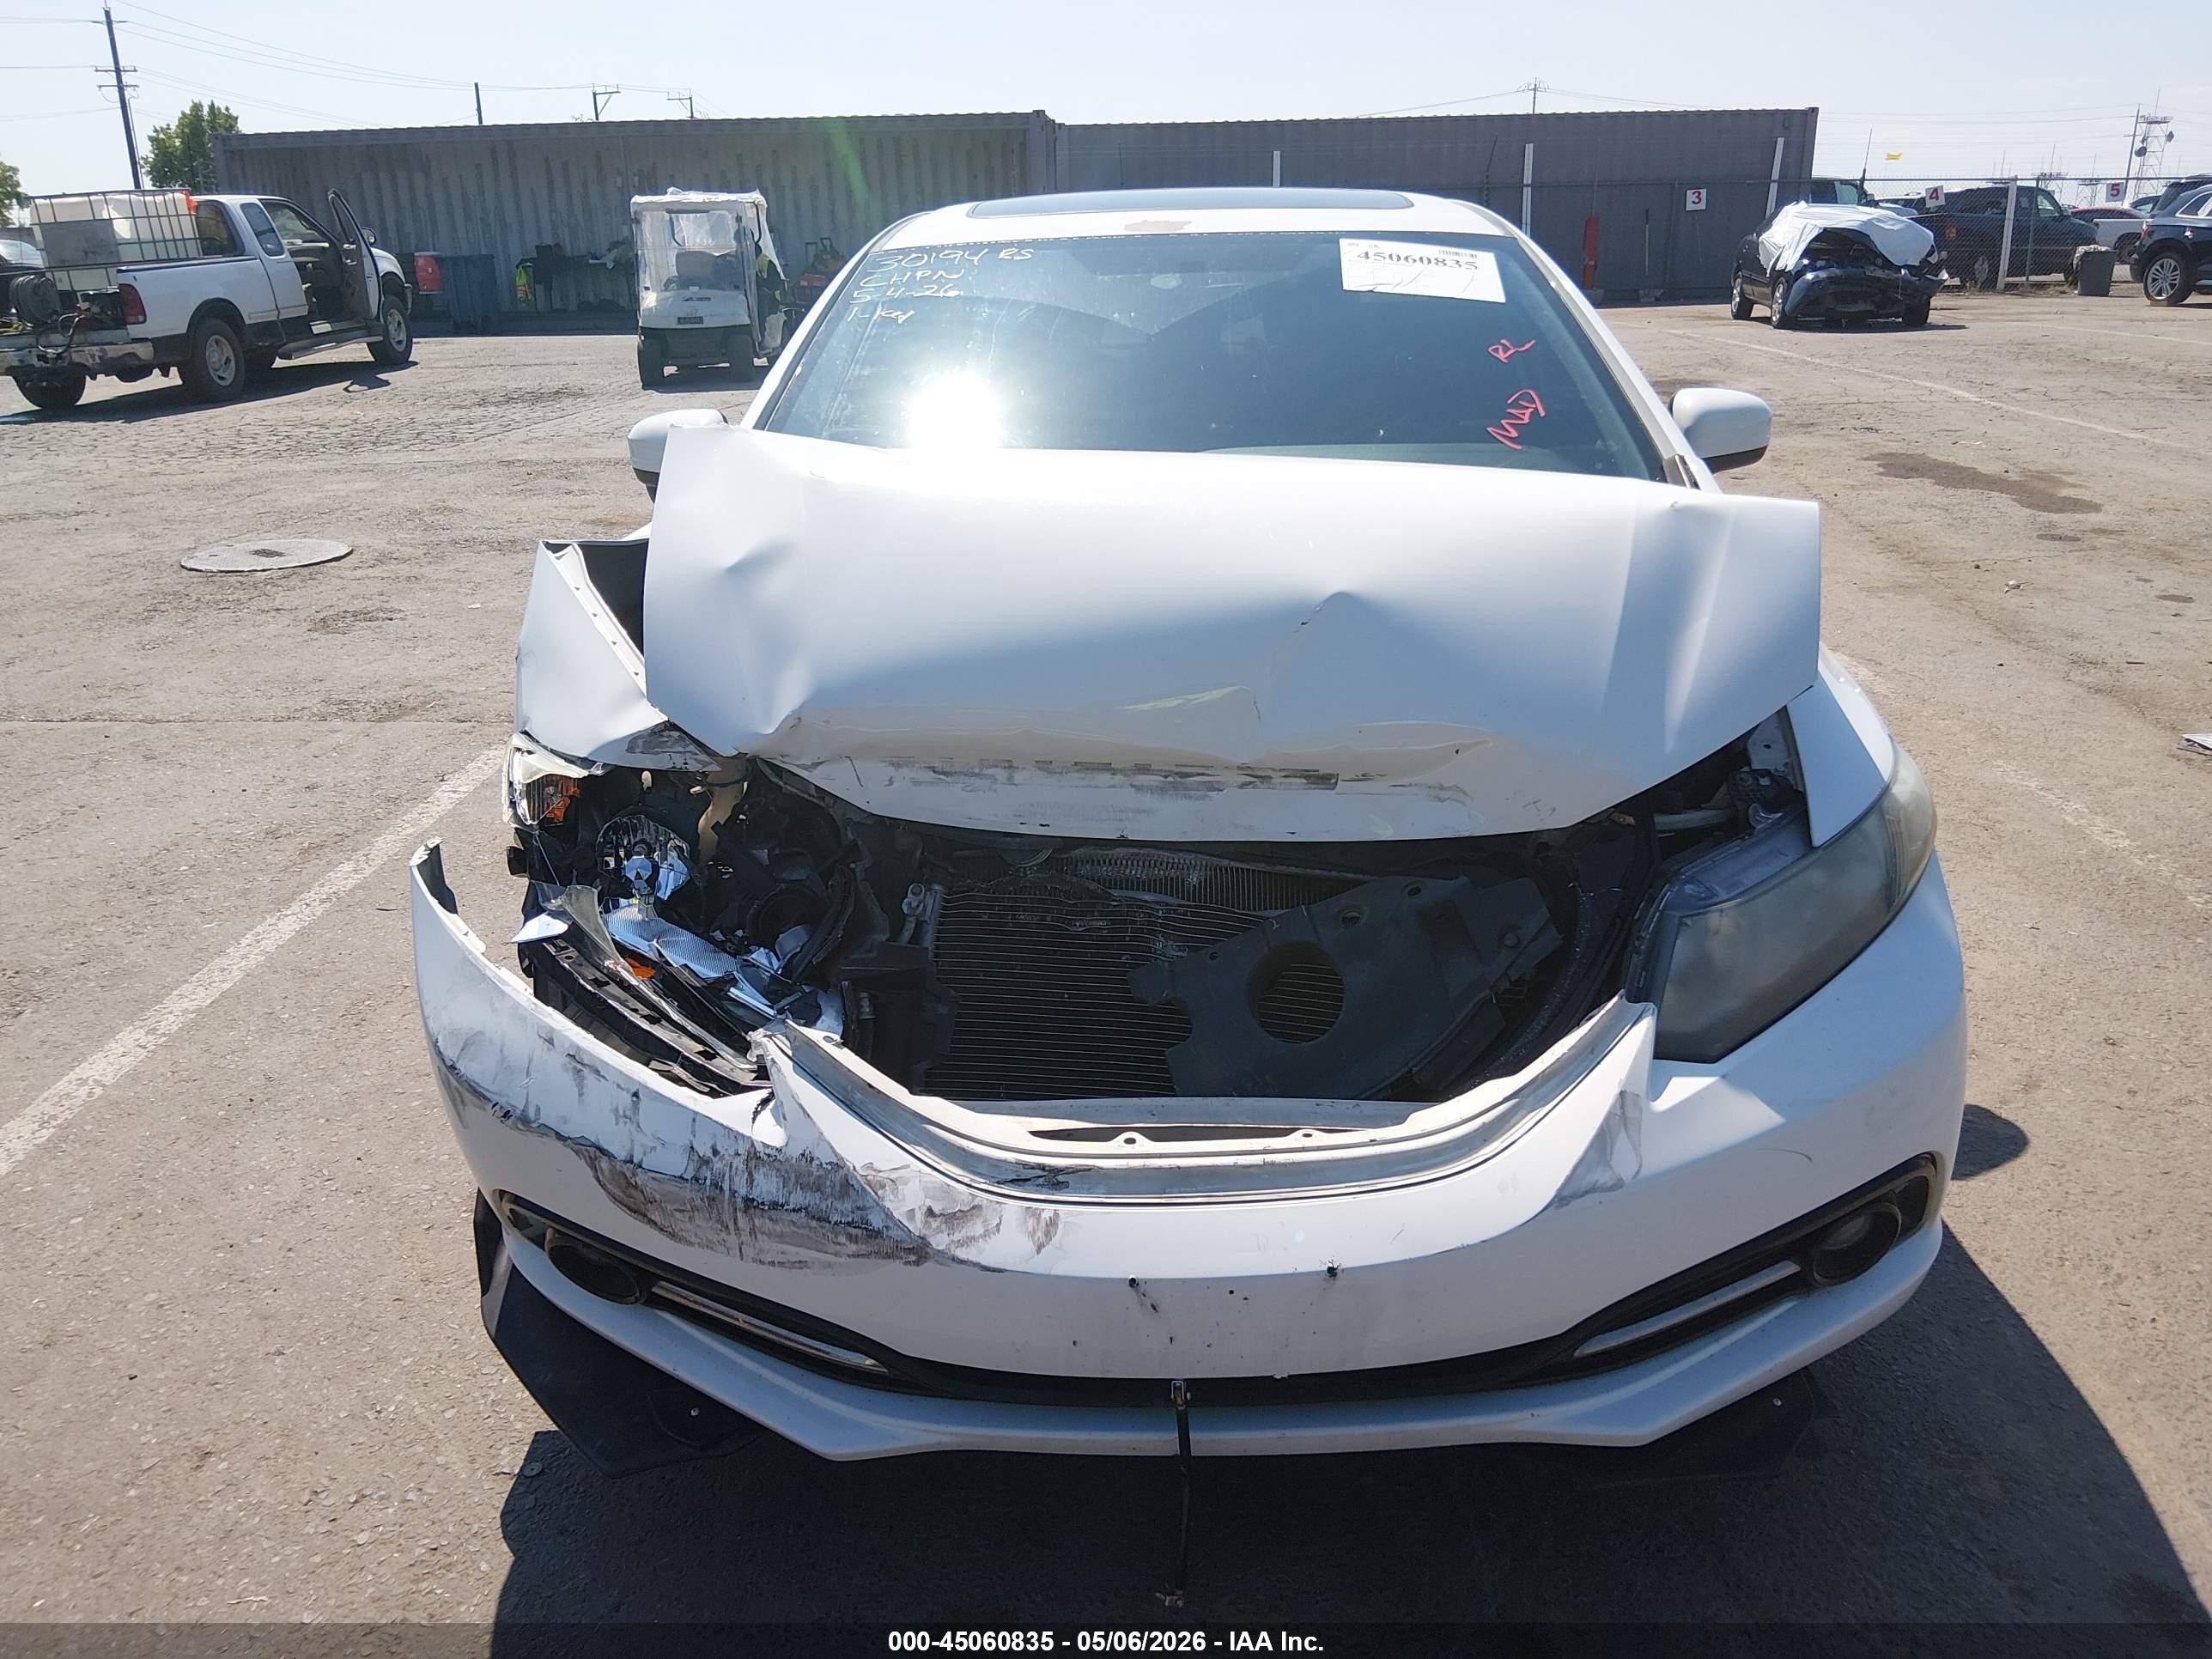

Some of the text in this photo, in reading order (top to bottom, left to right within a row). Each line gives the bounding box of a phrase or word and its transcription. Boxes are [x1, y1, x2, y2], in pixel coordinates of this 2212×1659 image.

[1692, 191, 1702, 204] 3
[1929, 187, 1939, 201] 4
[2110, 183, 2120, 198] 5
[866, 249, 989, 272] 30194
[1357, 250, 1478, 270] 45060835
